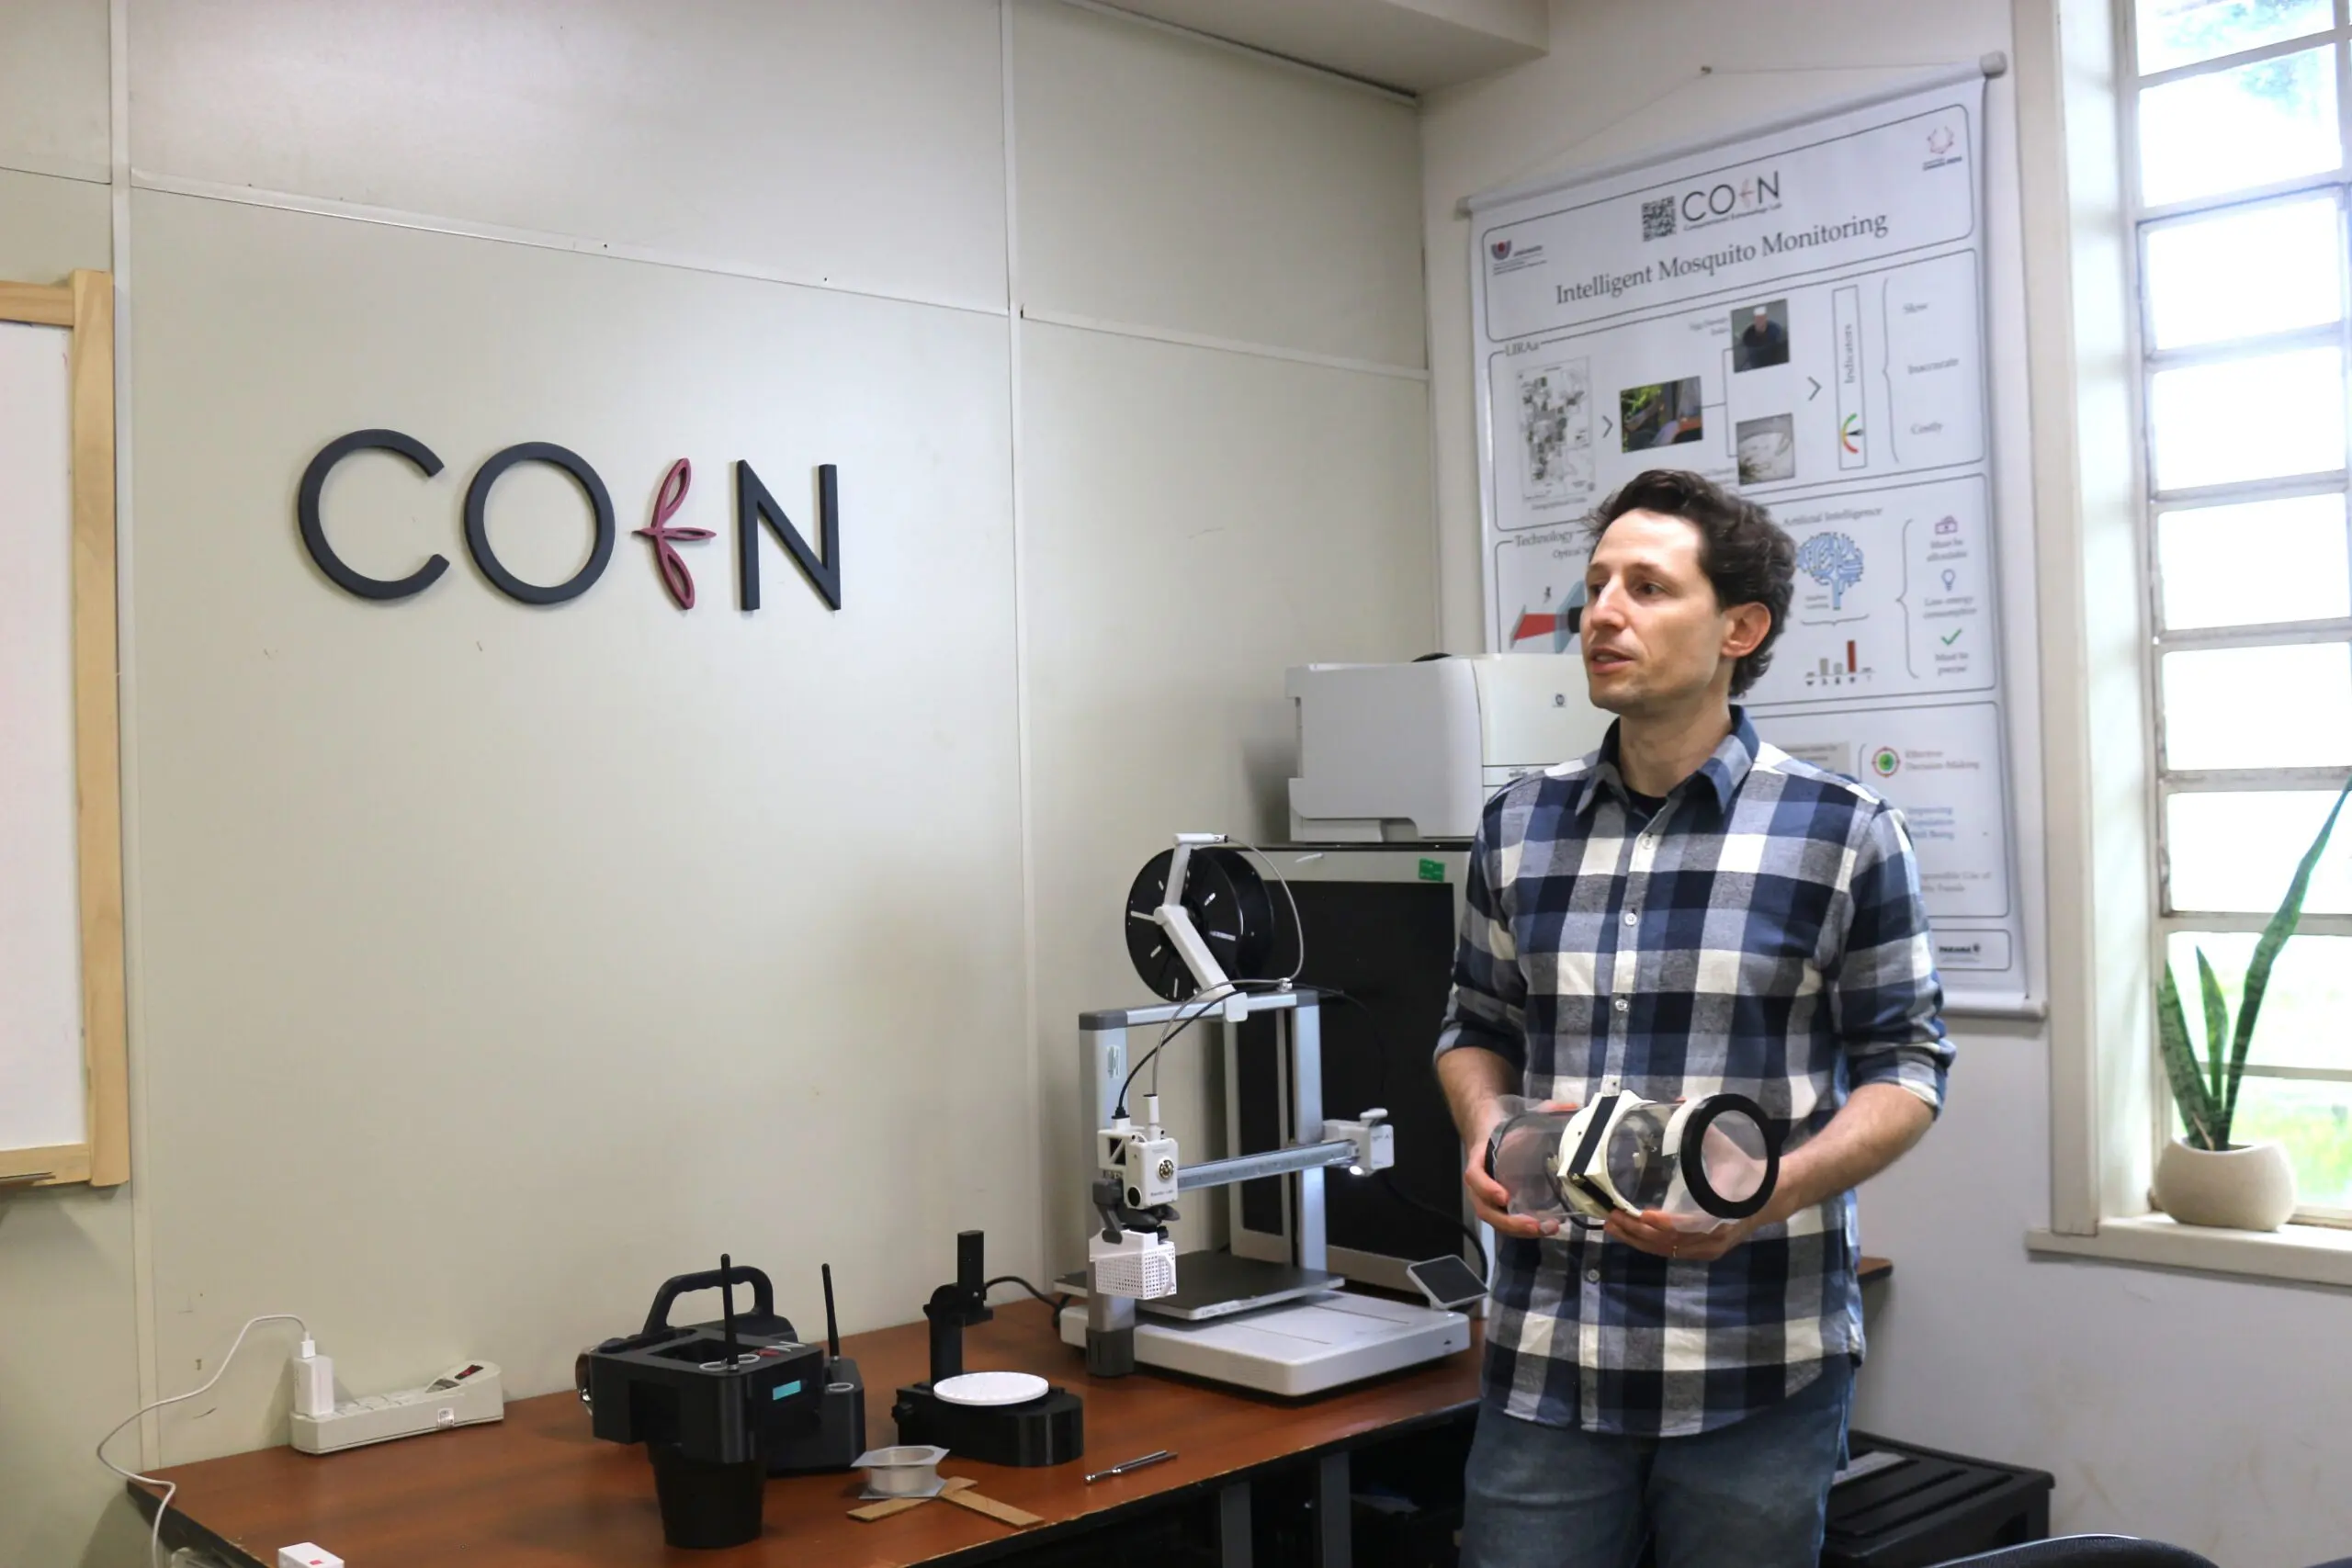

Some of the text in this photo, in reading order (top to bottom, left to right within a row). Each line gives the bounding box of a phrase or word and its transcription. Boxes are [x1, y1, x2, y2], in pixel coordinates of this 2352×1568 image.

[1555, 265, 1653, 305] Intelligent
[1658, 243, 1757, 280] Mosquito
[1761, 214, 1889, 257] Monitoring
[1844, 323, 1855, 384] Indicators
[1513, 530, 1573, 548] Technology
